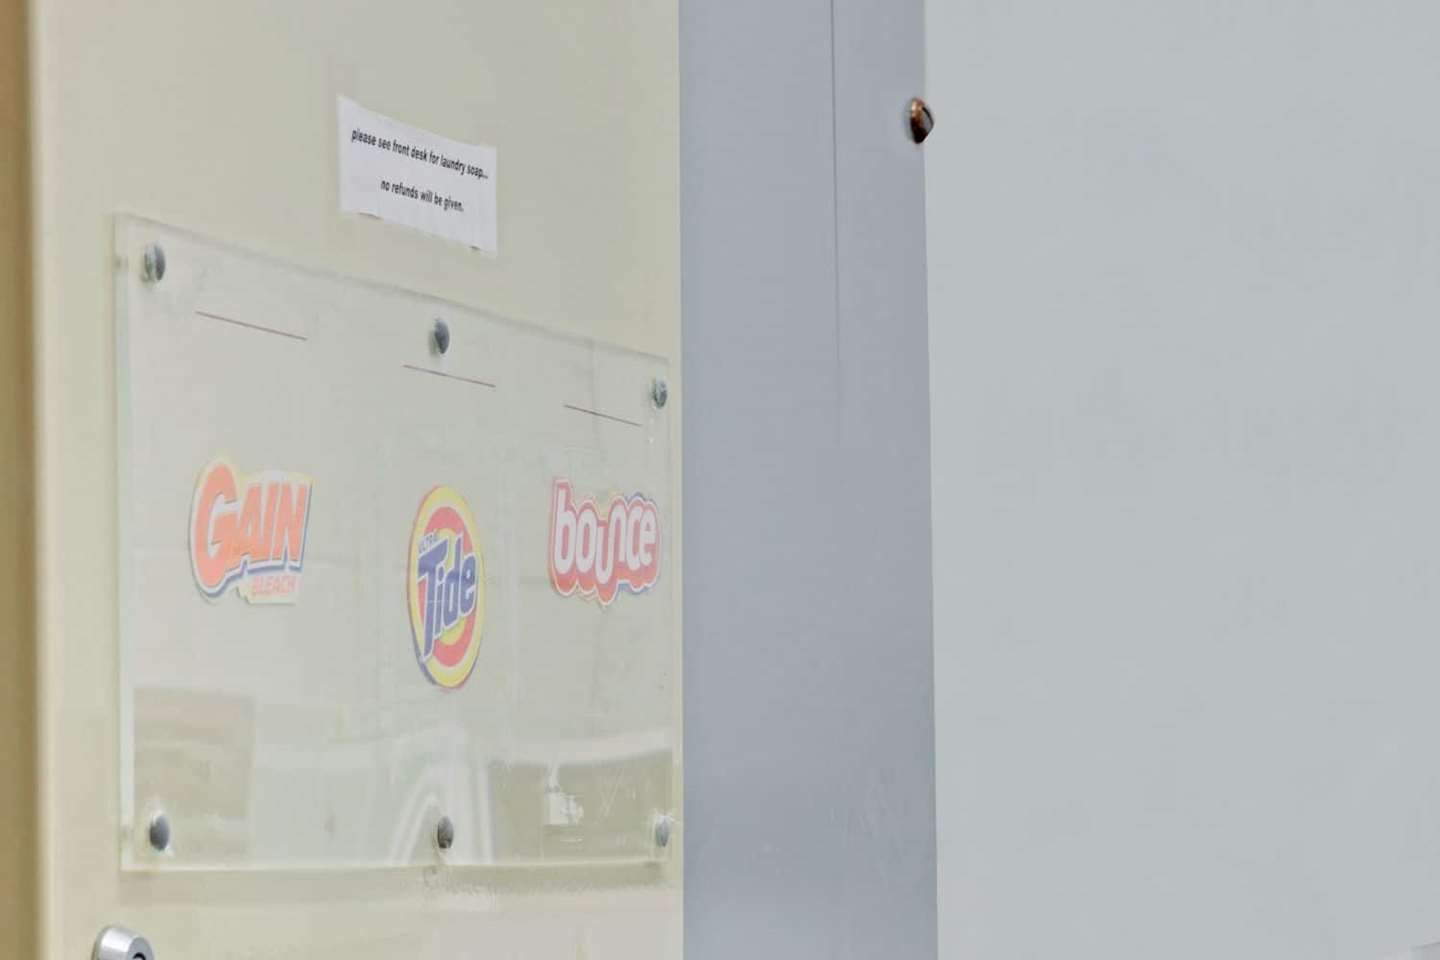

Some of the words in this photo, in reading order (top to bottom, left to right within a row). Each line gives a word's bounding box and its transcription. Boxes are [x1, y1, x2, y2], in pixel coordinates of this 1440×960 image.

[352, 128, 376, 146] please
[378, 136, 391, 150] see
[392, 138, 410, 157] front
[411, 145, 428, 162] desk
[429, 151, 440, 165] for
[440, 153, 466, 175] laundry
[380, 179, 390, 191] no
[391, 182, 419, 200] refunds
[420, 188, 433, 203] will
[434, 191, 443, 206] be
[195, 464, 308, 588] GAIN
[552, 485, 658, 586] bounce
[416, 531, 477, 660] Tide
